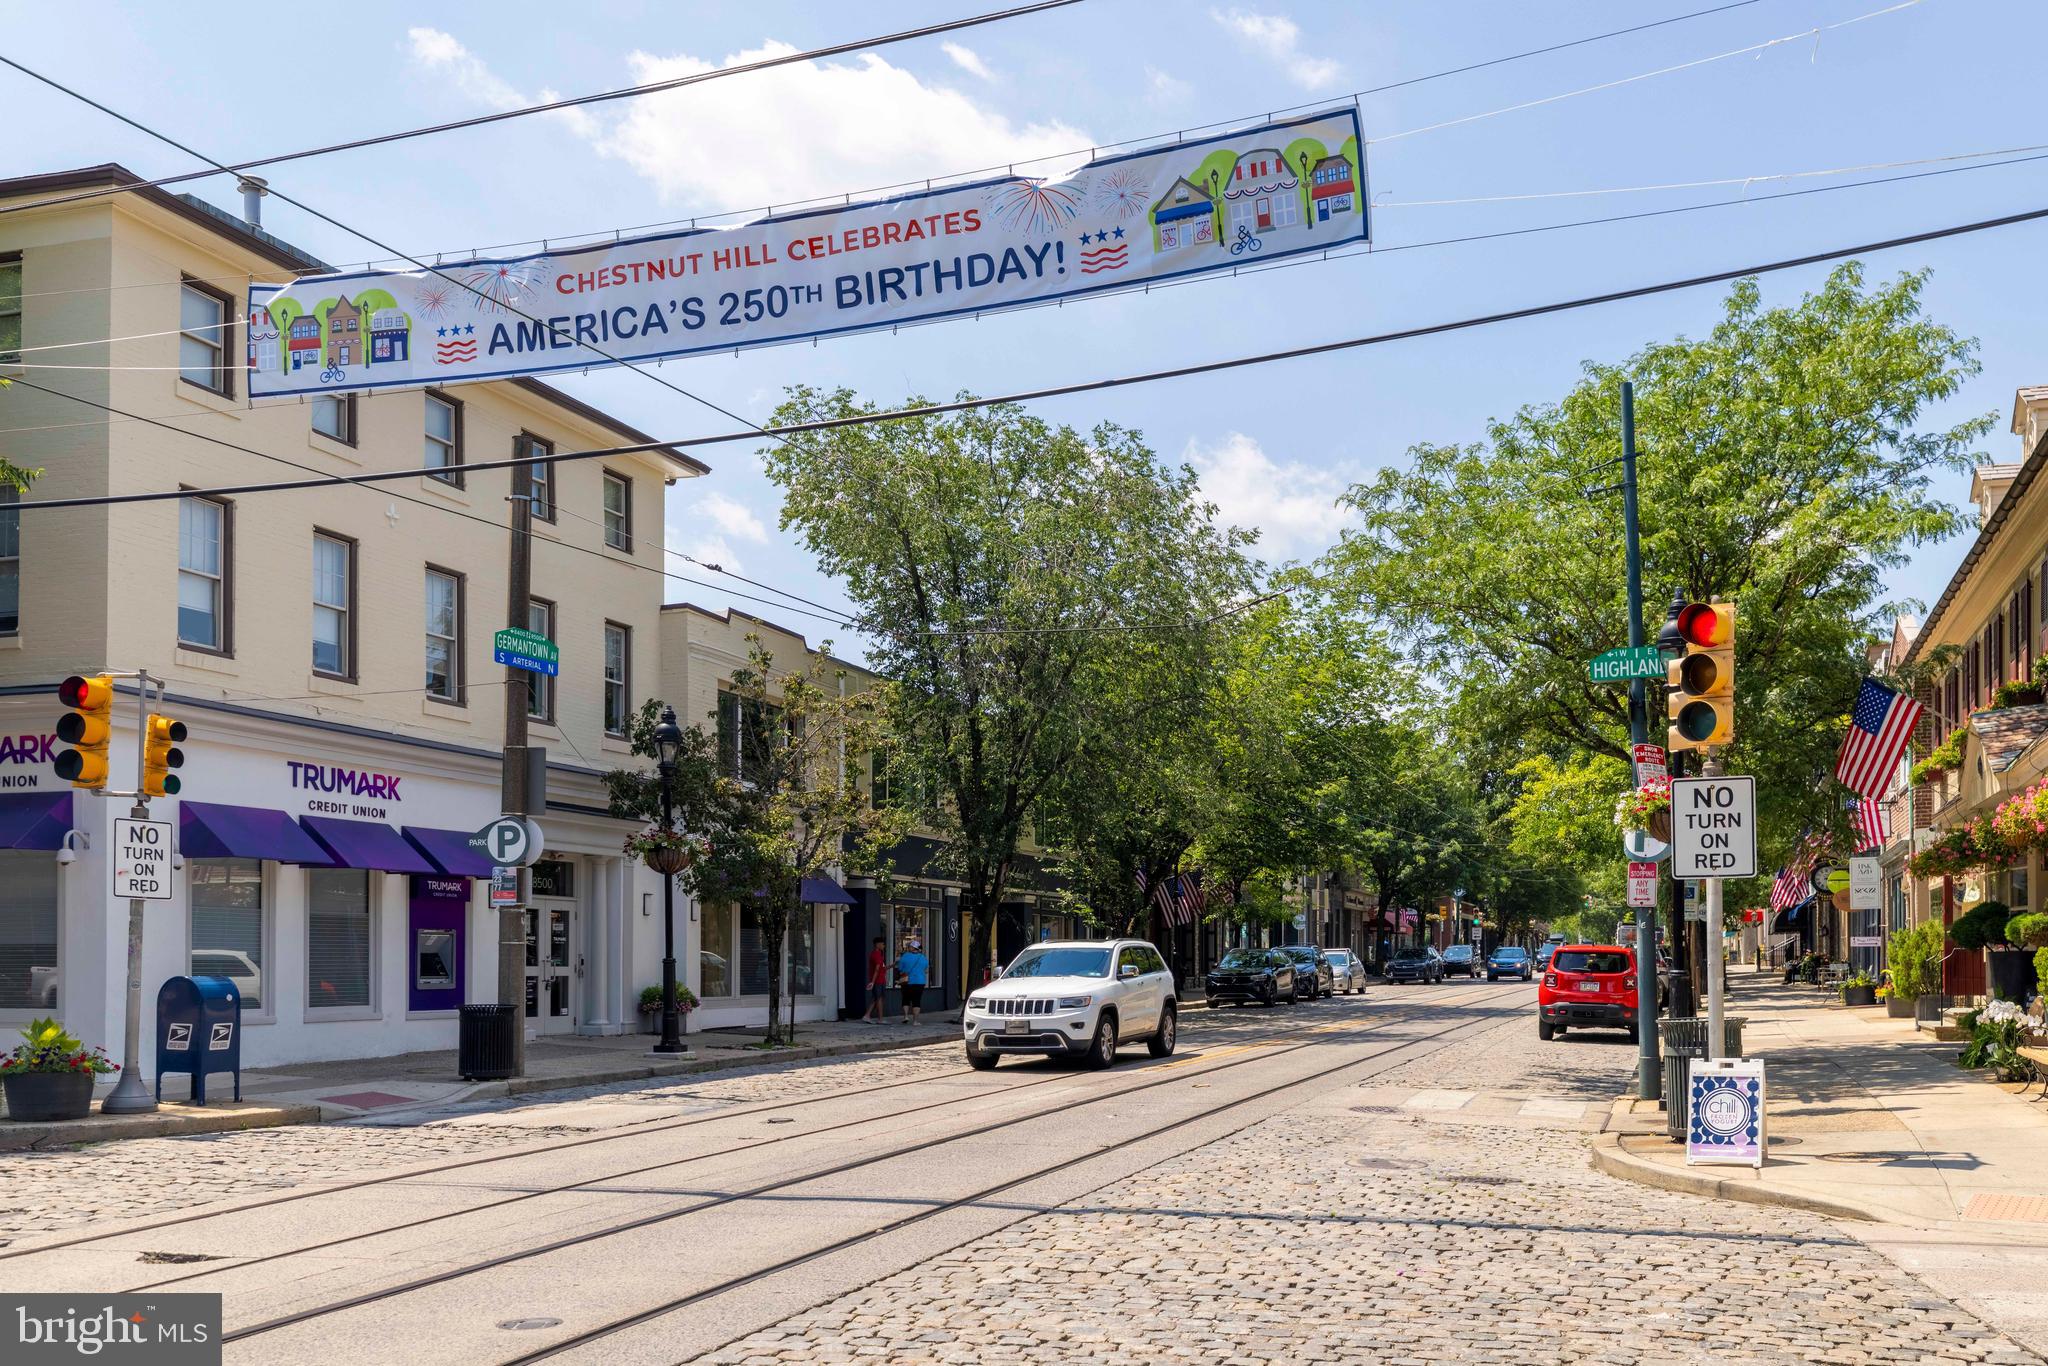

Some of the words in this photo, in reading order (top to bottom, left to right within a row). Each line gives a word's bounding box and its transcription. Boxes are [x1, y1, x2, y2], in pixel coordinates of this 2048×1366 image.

[556, 253, 703, 294] CHESTNUT
[713, 243, 777, 272] HILL
[787, 209, 982, 261] CELEBRATES
[488, 297, 706, 356] AMERICA'S
[718, 283, 823, 326] 250TH
[835, 240, 1065, 310] BIRTHDAY!
[497, 633, 549, 659] GERMANTOWN
[499, 652, 505, 663] S
[512, 656, 541, 670] ARTERIAL
[547, 664, 554, 674] N
[287, 760, 402, 801] TRUMARK
[1693, 786, 1734, 809] NO
[308, 800, 348, 814] CREDIT
[352, 805, 386, 819] UNION
[1684, 812, 1742, 829] TURN
[130, 826, 159, 844] NO
[497, 825, 521, 858] P
[1700, 833, 1729, 849] ON
[124, 846, 164, 861] TURN
[1695, 853, 1736, 869] RED
[134, 863, 155, 876] ON
[130, 879, 159, 892] RED
[427, 880, 462, 892] TRUMARK
[1635, 880, 1649, 888] ANY
[1709, 1099, 1736, 1113] chill
